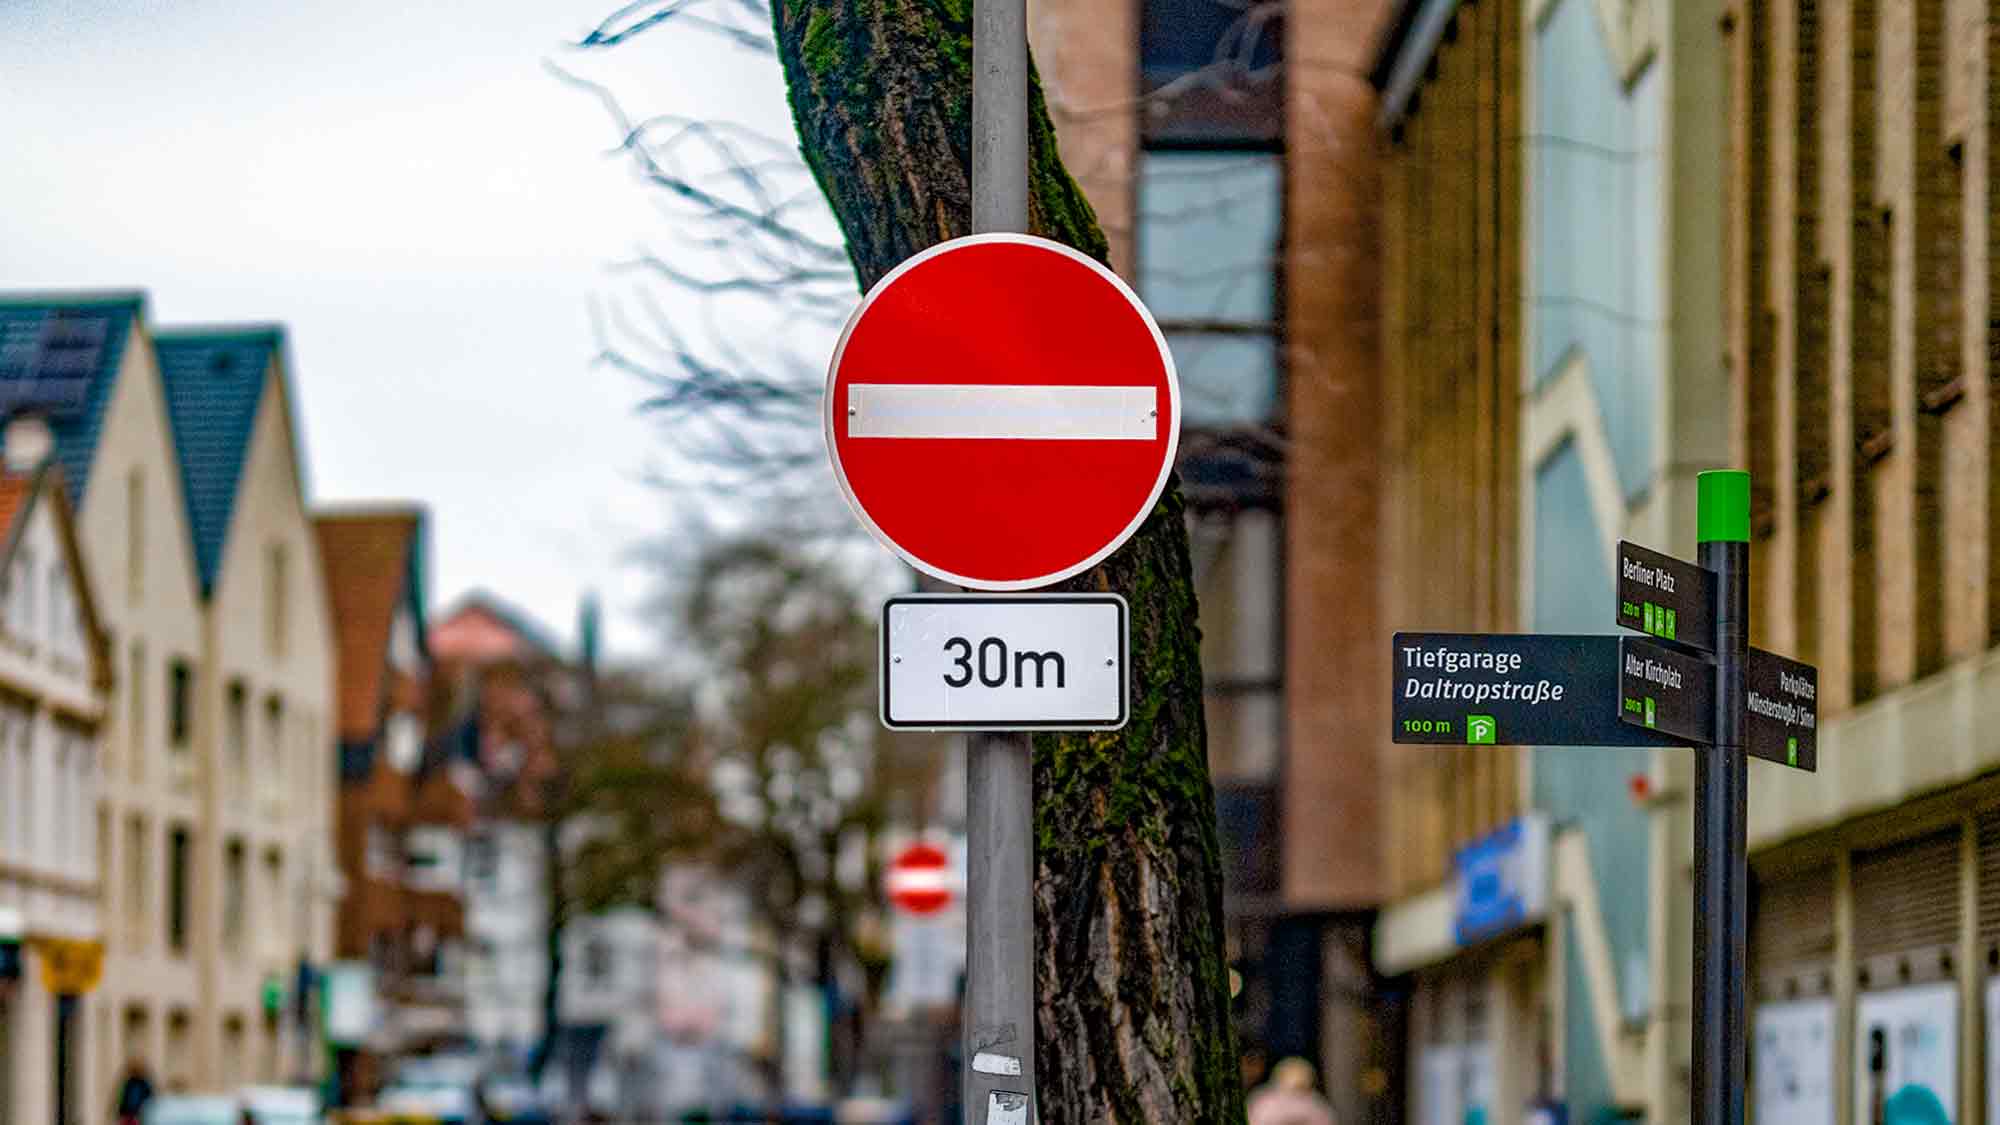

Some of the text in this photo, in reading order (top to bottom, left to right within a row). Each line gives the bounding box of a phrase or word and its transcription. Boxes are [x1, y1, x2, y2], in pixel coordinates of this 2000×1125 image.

[1623, 557, 1674, 593] Berliner Platz
[943, 636, 1066, 689] 30m
[1403, 647, 1522, 673] Tiefgarage
[1625, 653, 1682, 689] Alter Kirchplatz
[1404, 678, 1564, 705] Daltropstraße
[1780, 671, 1815, 701] Parkplätze
[1403, 720, 1451, 733] 100 m
[1747, 691, 1796, 727] Münsterstraße
[1800, 707, 1815, 729] Sinn
